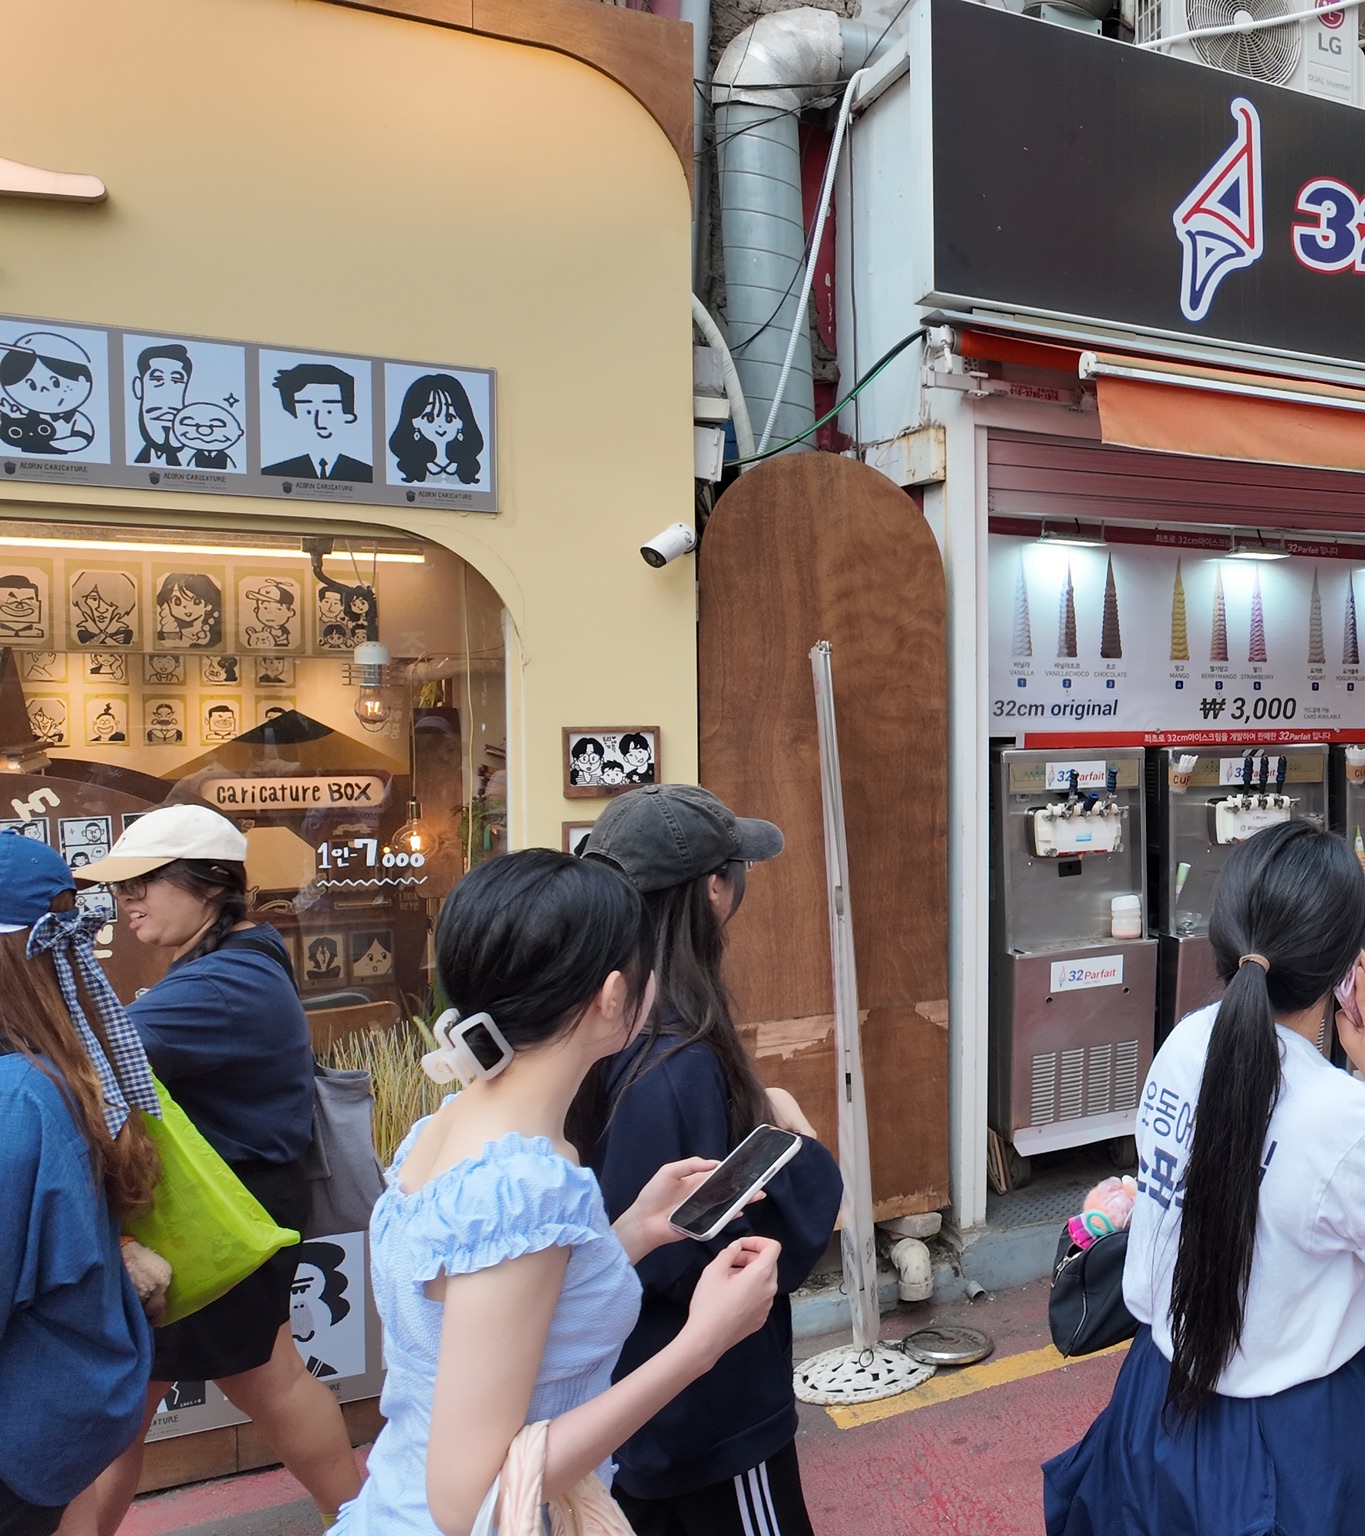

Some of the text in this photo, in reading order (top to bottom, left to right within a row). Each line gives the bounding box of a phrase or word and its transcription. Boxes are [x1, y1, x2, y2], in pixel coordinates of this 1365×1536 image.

[1318, 32, 1342, 55] LG
[1308, 74, 1350, 92] DUAL Inverter
[19, 462, 88, 473] ACORN CARICATURE
[163, 472, 226, 483] ACORN CARICATURE
[295, 481, 315, 489] ACORN
[418, 490, 436, 498] ACORN
[993, 699, 1119, 721] 32cm original
[1230, 697, 1297, 724] 3,000
[1144, 733, 1166, 743] 최초로
[1312, 731, 1331, 740] 입니다
[1057, 770, 1104, 783] 32arfait
[216, 782, 372, 804] caricature BOX
[1068, 968, 1116, 982] 32Parfait
